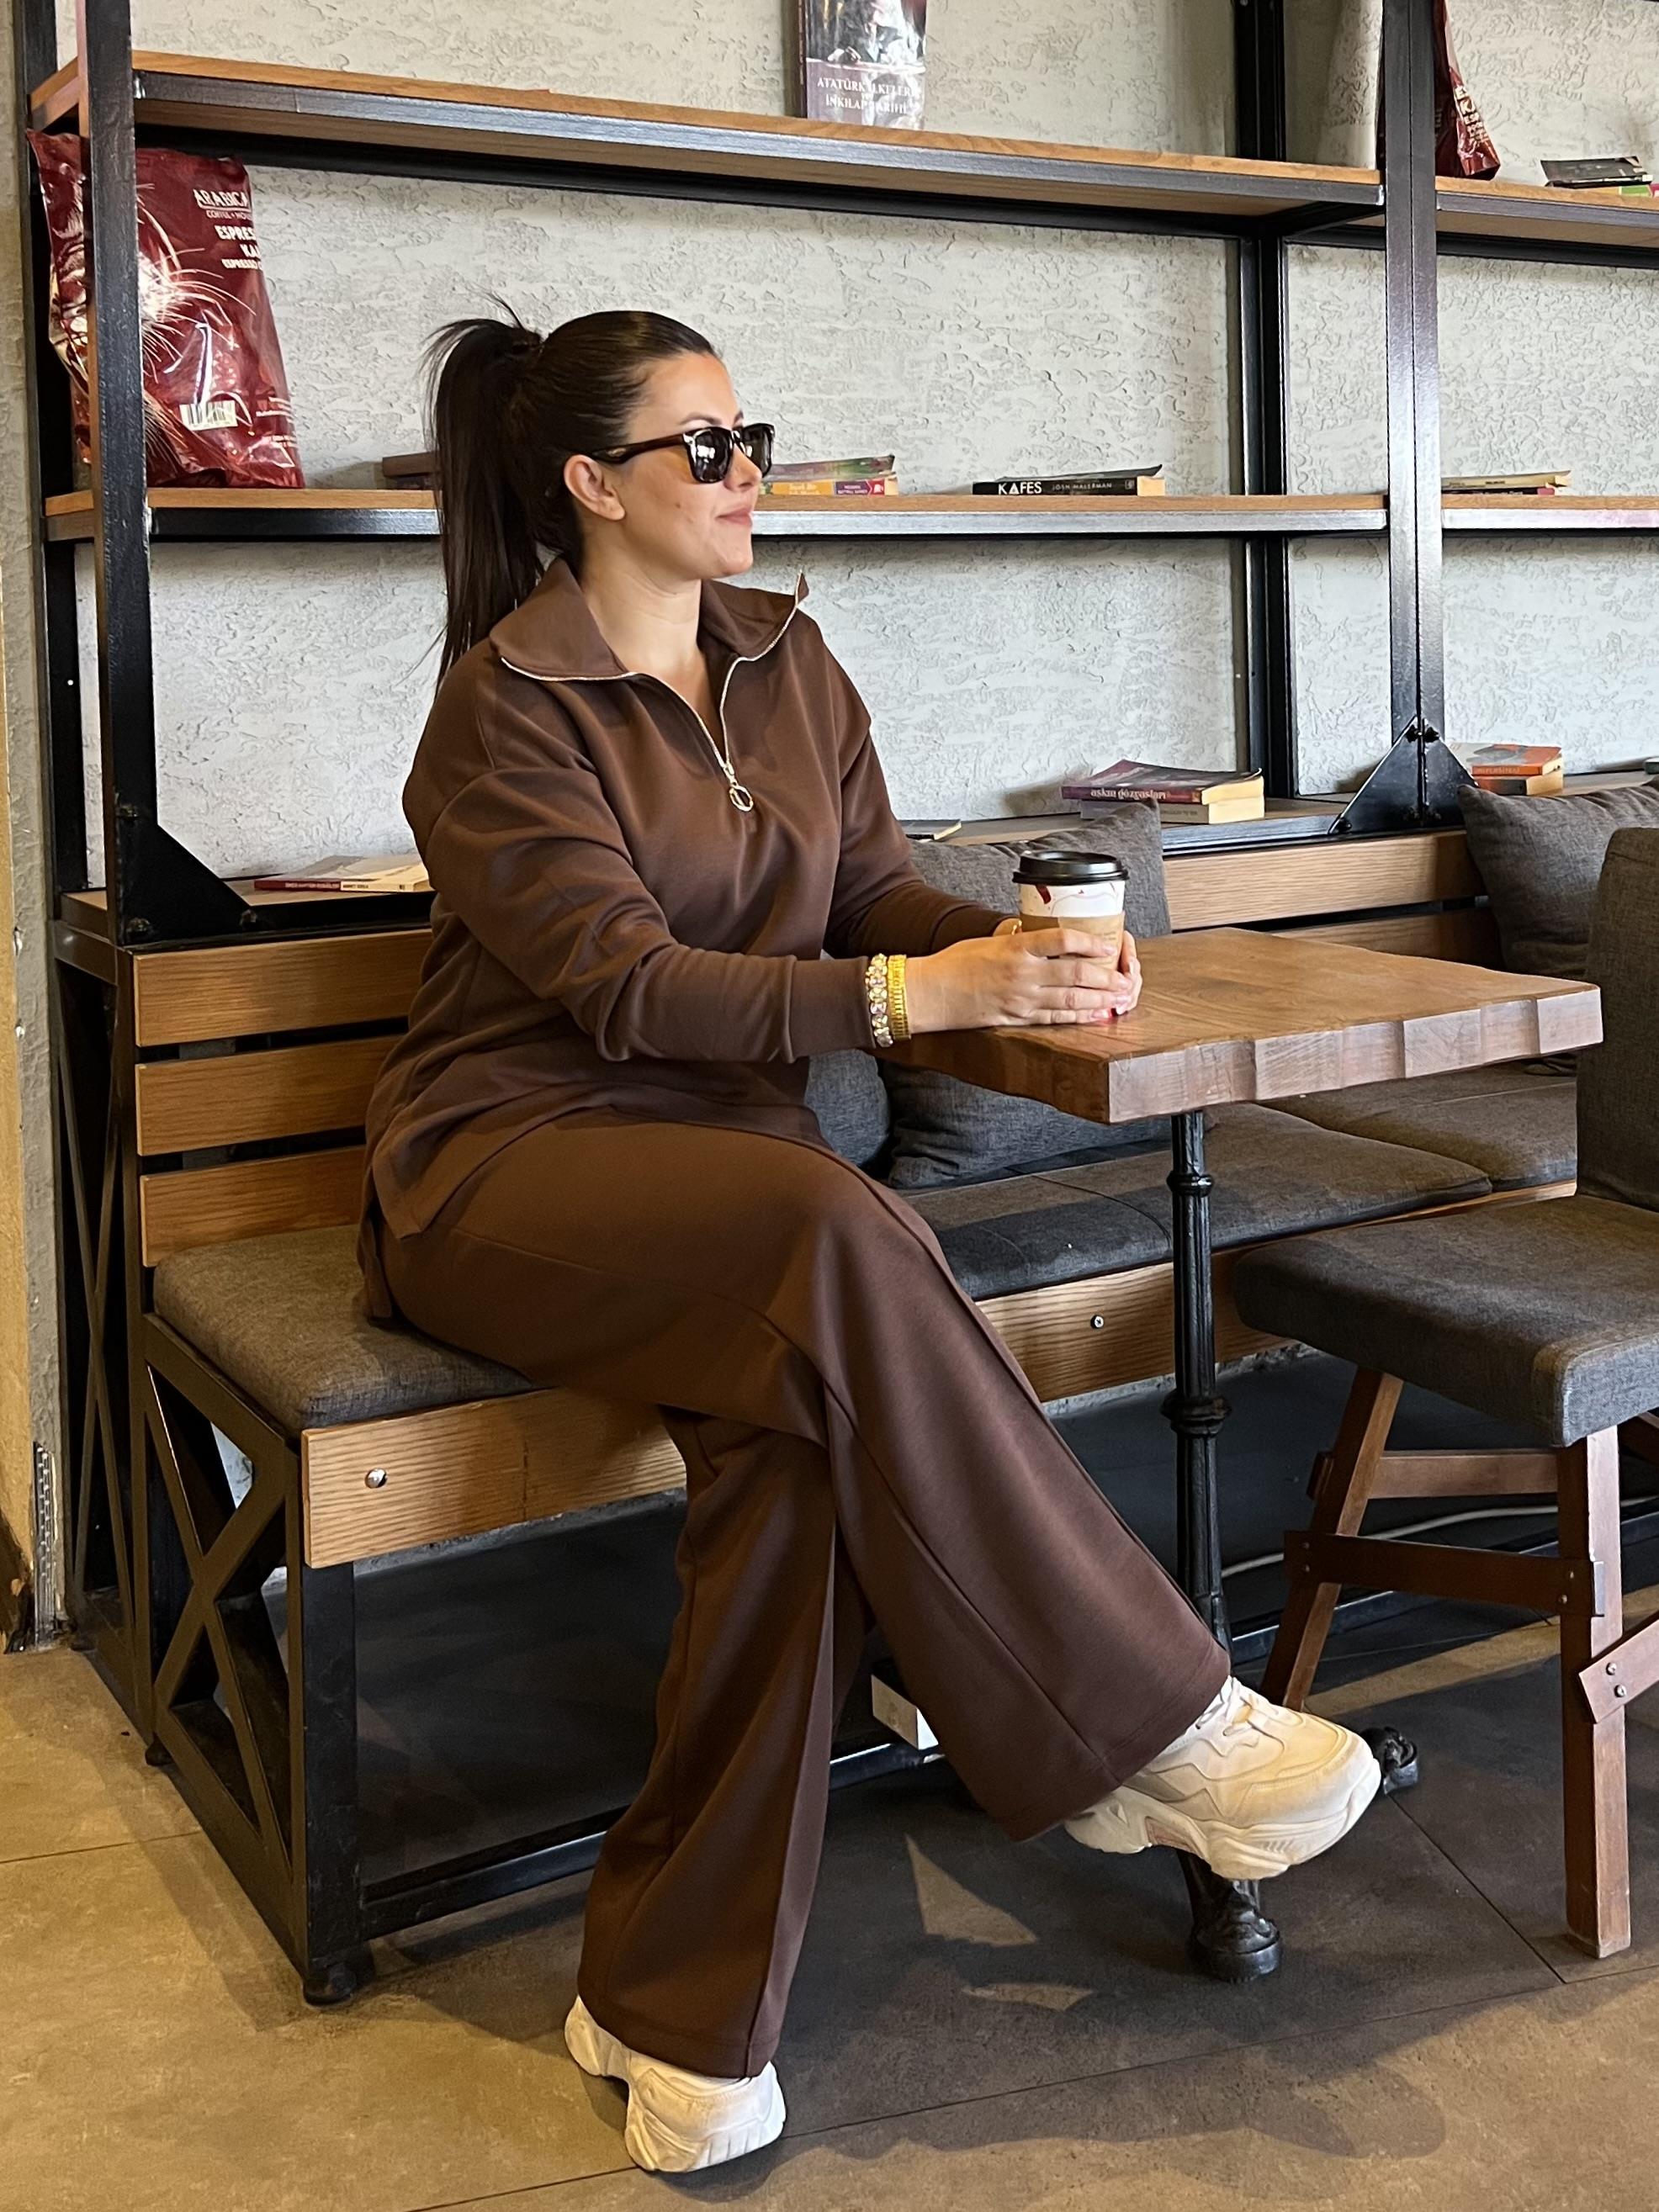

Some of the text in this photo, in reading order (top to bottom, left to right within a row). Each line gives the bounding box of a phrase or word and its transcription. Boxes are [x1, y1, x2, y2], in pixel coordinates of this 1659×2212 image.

[817, 77, 866, 93] ATATÜRK
[193, 188, 248, 207] ARABICA
[998, 481, 1042, 495] KAFES
[1072, 482, 1113, 490] MALERMAN
